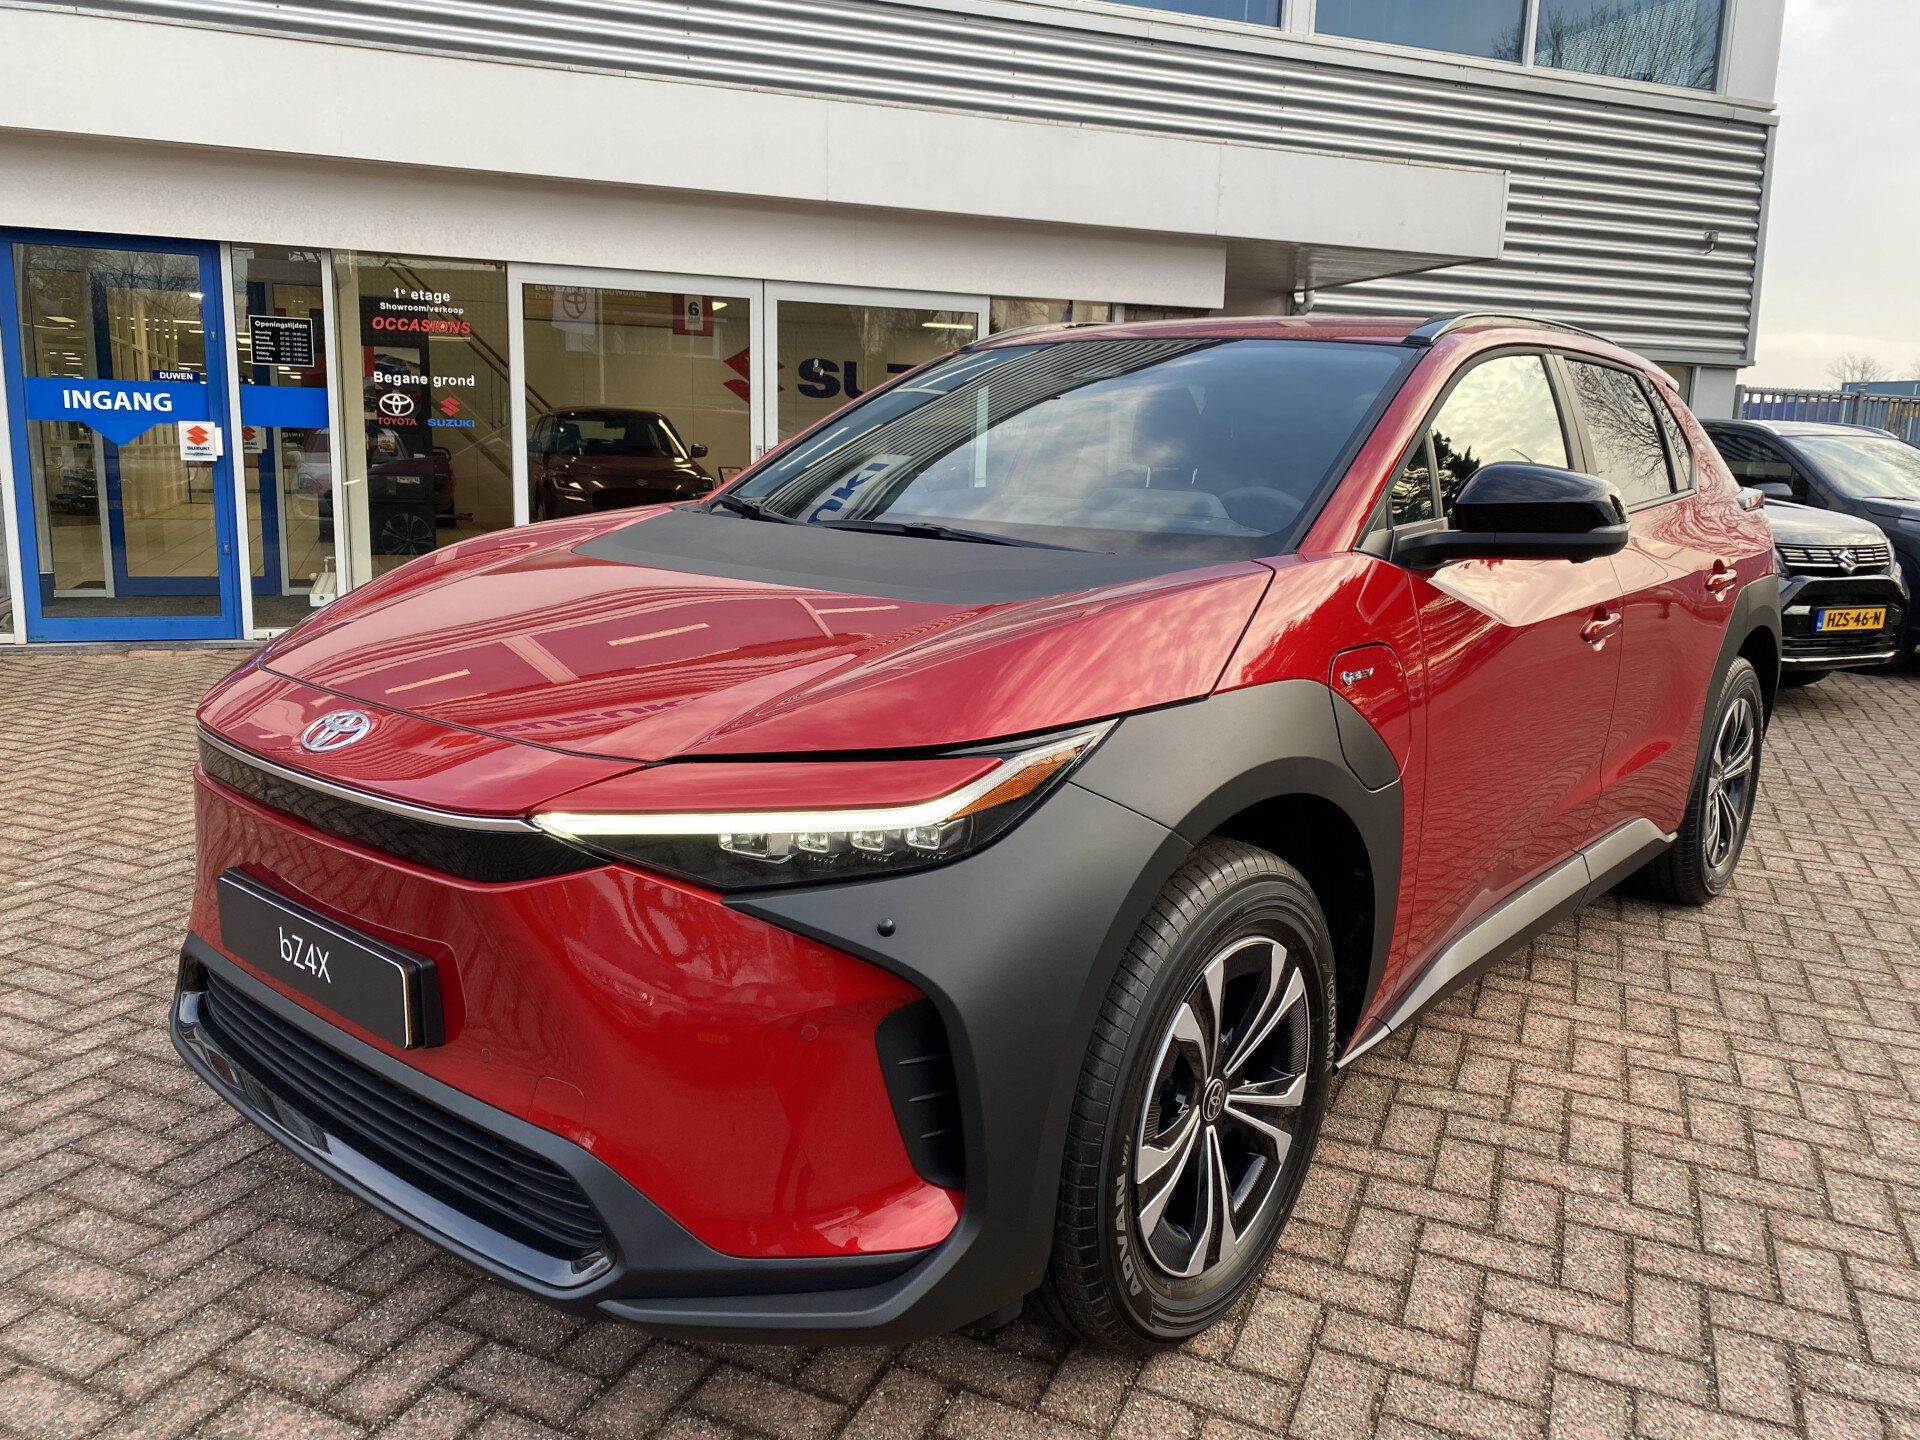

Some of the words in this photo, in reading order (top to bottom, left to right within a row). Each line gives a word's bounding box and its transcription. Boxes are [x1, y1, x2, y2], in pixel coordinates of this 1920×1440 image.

[411, 290, 450, 303] etage
[380, 302, 464, 315] Showroom/verkoop
[688, 302, 699, 316] 6
[254, 320, 308, 330] Openingstijden
[372, 316, 471, 334] OCCASIONS
[159, 371, 193, 380] DUWEN
[373, 372, 428, 386] Begane
[433, 375, 475, 387] grond
[63, 389, 172, 412] INGANG
[377, 417, 417, 426] TOYOTA
[428, 418, 475, 427] SUZUKI
[1827, 612, 1882, 628] HZS-46-N
[279, 926, 331, 984] bZ4X
[1325, 974, 1337, 1073] YOKOHAMA
[1115, 1172, 1143, 1297] ADVAN
